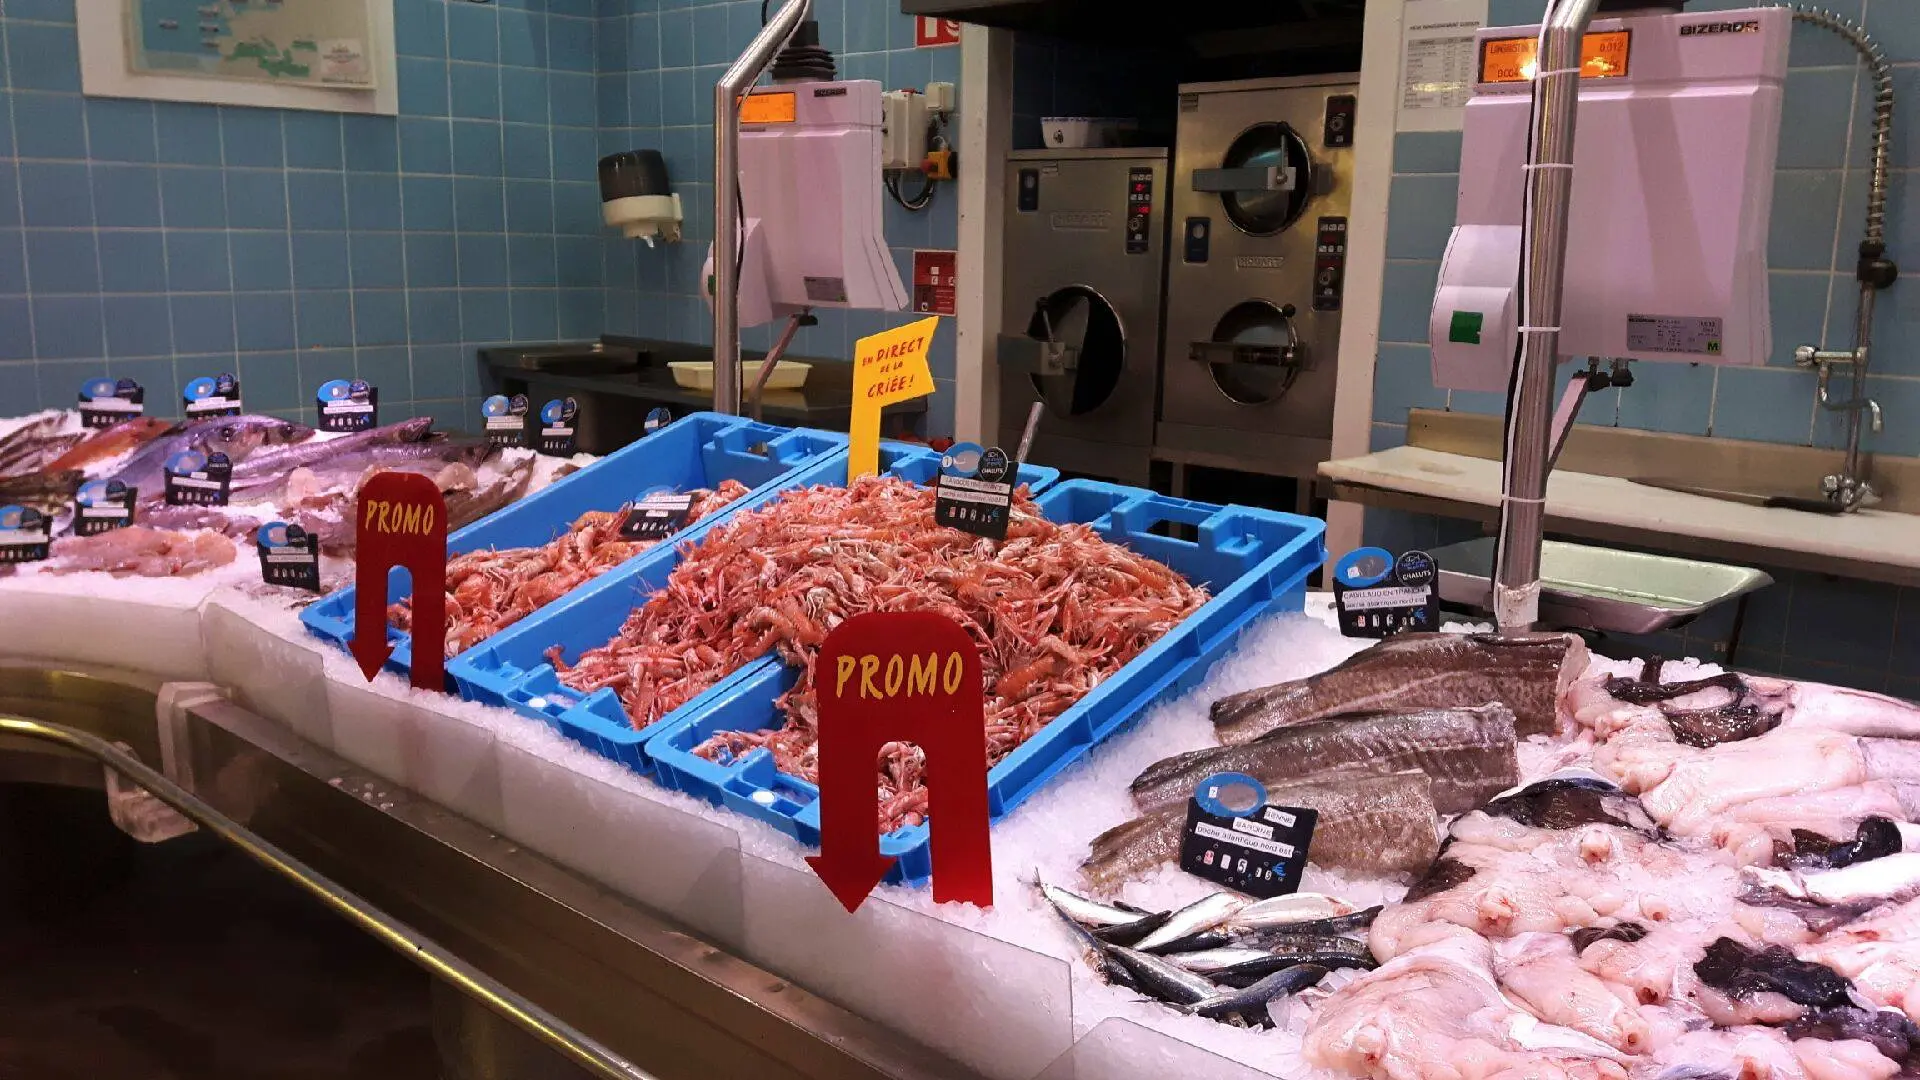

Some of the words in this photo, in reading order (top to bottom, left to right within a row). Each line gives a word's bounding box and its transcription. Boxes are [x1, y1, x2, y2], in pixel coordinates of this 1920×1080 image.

[862, 356, 874, 367] EN
[876, 336, 924, 362] DIRECT
[365, 500, 434, 536] PROMO
[1402, 570, 1431, 581] CHALUTS
[836, 651, 963, 700] PROMO
